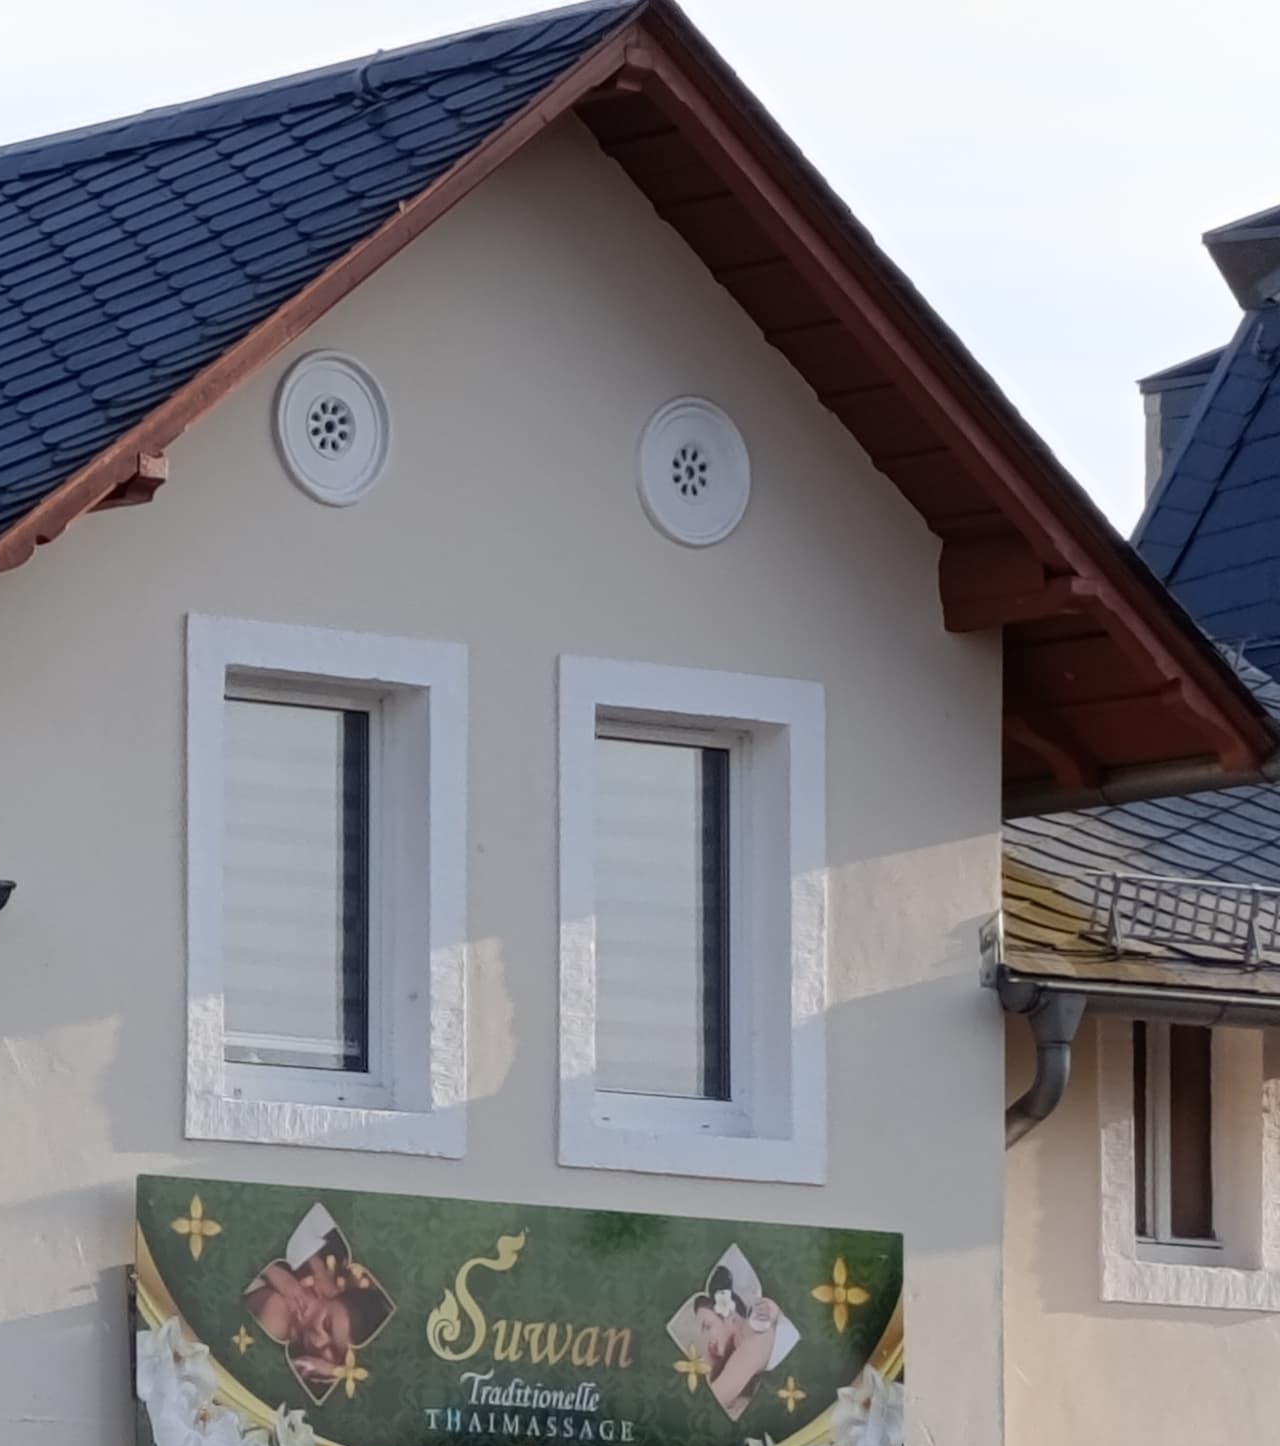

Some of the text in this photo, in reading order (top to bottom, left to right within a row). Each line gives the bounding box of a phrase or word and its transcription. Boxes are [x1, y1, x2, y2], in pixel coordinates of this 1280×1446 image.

[426, 1227, 634, 1369] Suwan
[460, 1369, 601, 1413] Traditionelle
[424, 1407, 636, 1442] THAIMASSAGE
